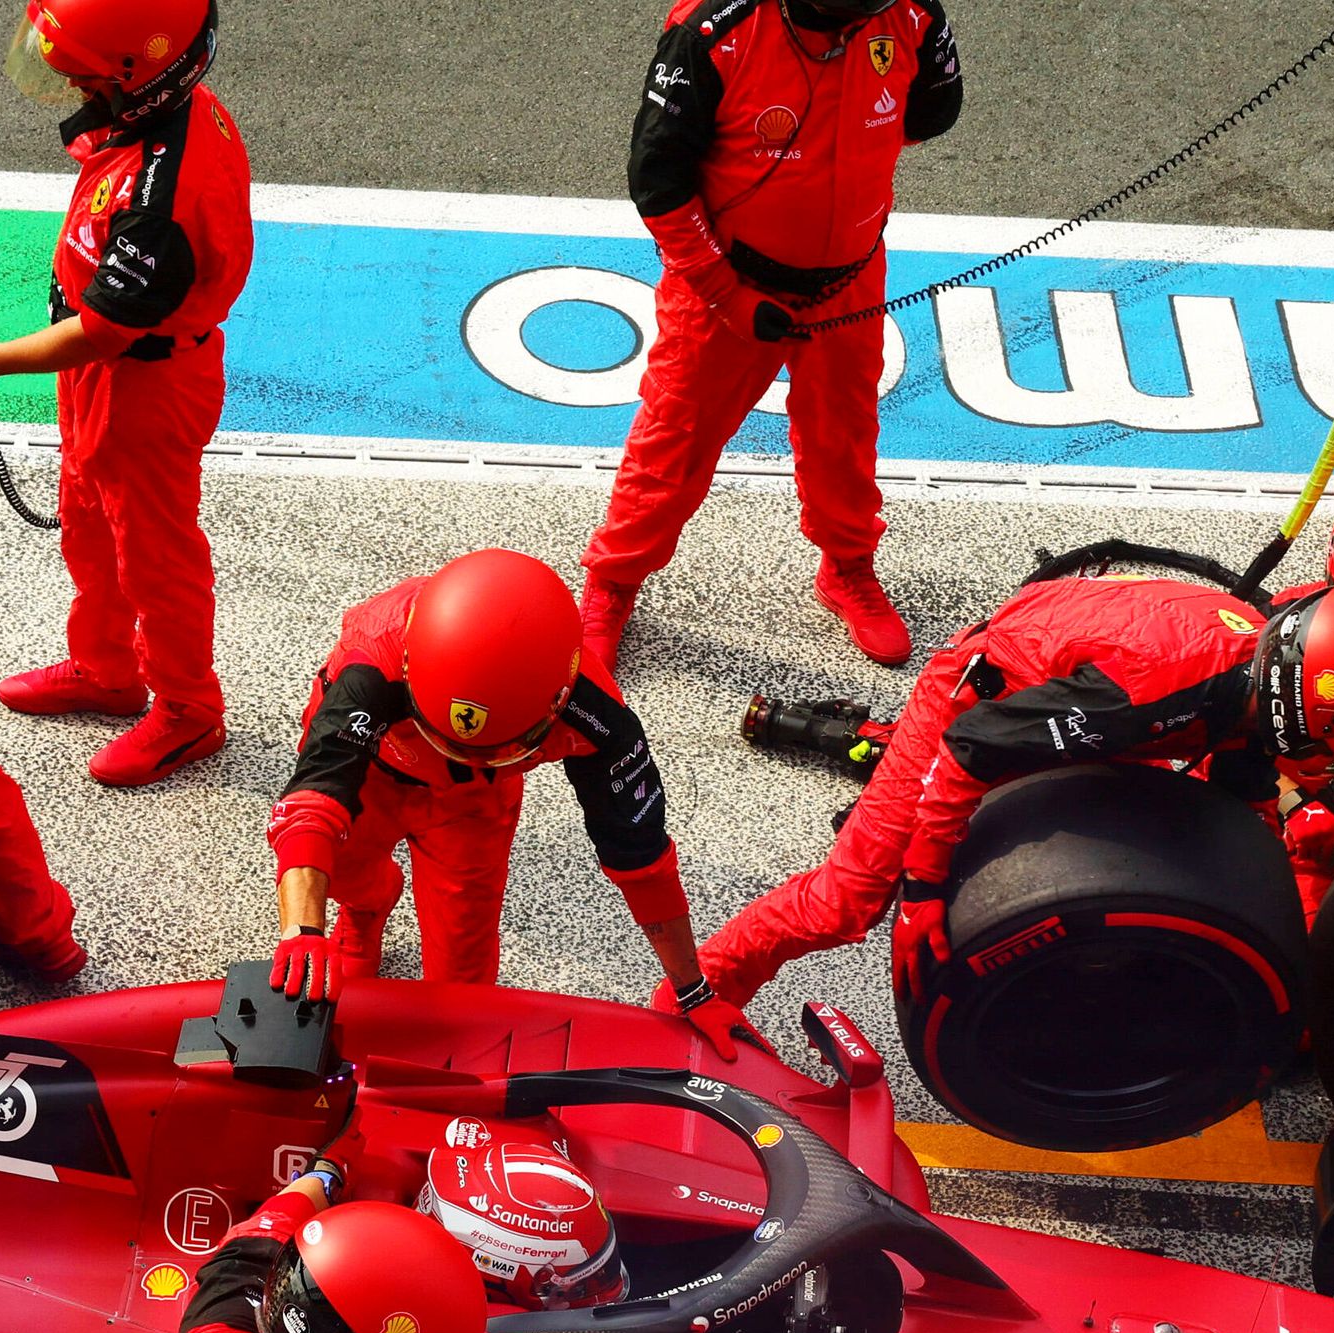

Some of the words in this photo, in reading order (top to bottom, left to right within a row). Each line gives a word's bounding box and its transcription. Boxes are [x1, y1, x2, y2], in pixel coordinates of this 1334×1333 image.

[1294, 664, 1303, 708] RICHARD
[567, 700, 610, 737] Snapdragon
[967, 914, 1068, 977] PIRELLI
[827, 1018, 866, 1059] VELAS
[687, 1075, 729, 1094] aws
[489, 1203, 574, 1234] Santander
[470, 1229, 568, 1259] #essereFerrari
[491, 1257, 515, 1276] WAR
[714, 1260, 809, 1326] Snapdragon
